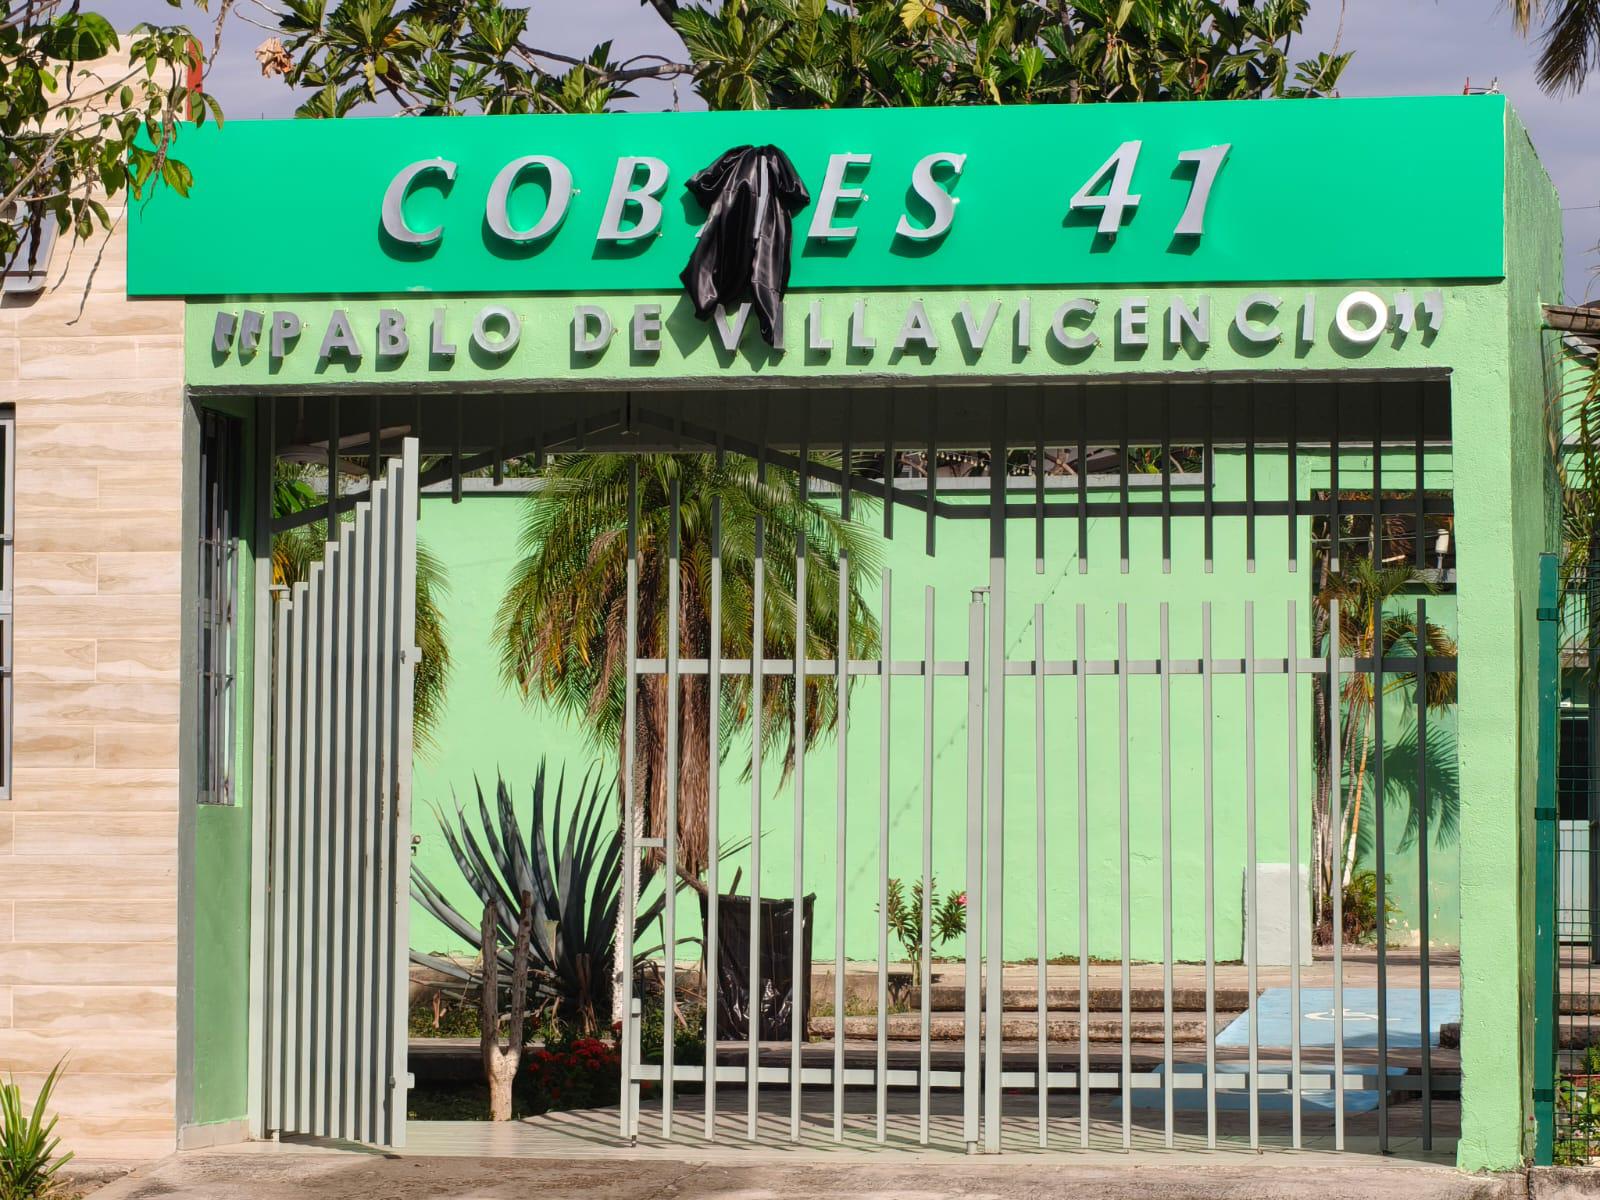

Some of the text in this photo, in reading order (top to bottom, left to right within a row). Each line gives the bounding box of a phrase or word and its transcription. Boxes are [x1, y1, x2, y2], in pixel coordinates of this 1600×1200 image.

[380, 140, 1232, 244] COBES 41
[574, 303, 662, 352] DE
